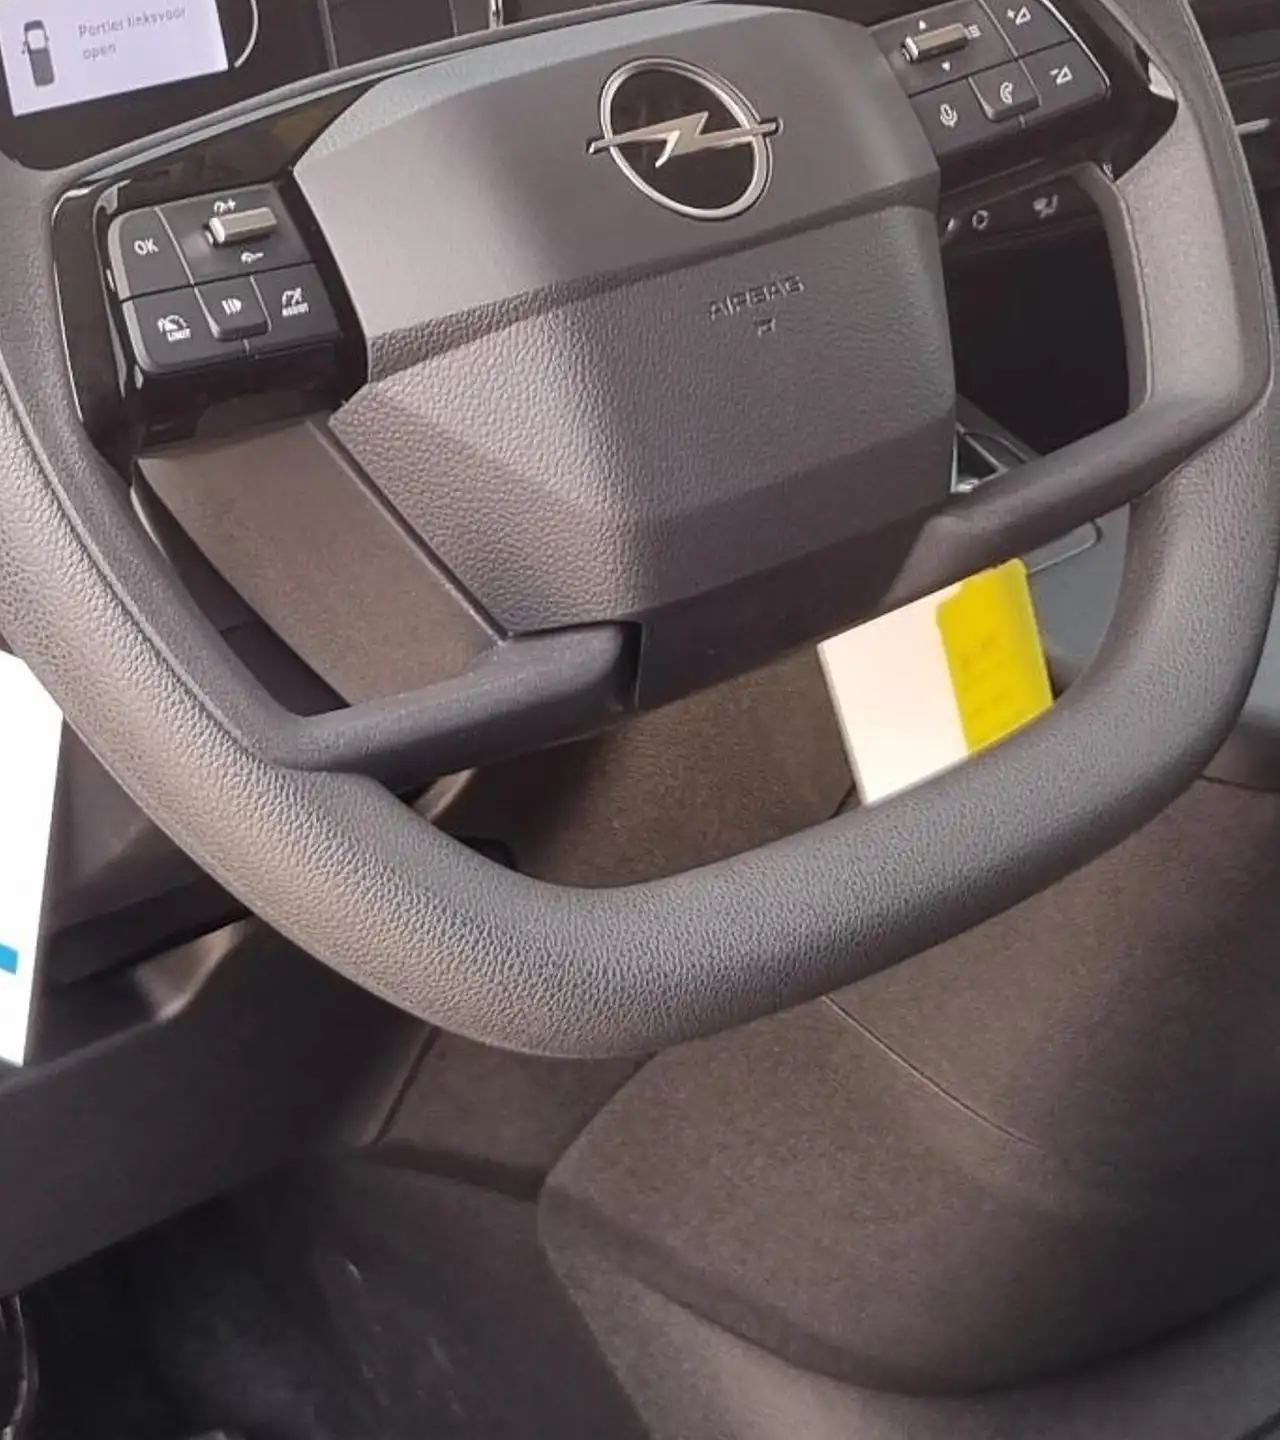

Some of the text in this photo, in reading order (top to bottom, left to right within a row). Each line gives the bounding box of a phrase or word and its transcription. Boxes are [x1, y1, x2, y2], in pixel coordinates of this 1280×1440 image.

[83, 43, 116, 61] open
[134, 238, 159, 256] OK
[709, 275, 805, 322] AIRBAG
